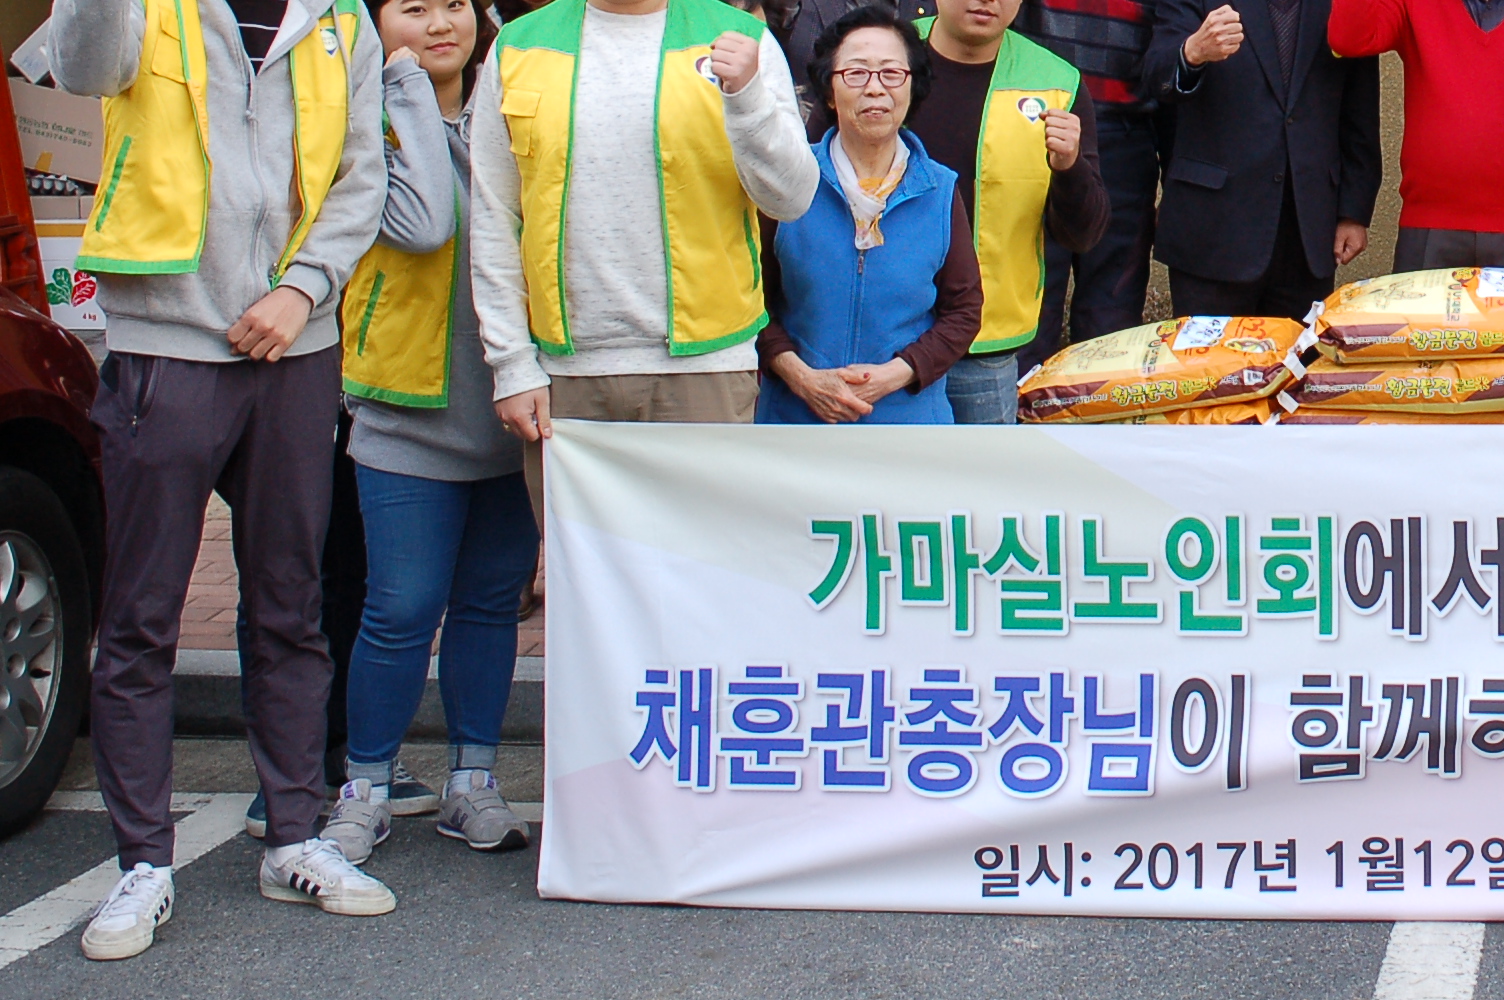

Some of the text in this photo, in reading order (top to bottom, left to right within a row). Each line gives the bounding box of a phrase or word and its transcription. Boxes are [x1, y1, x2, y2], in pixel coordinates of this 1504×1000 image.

[629, 664, 1248, 793] 채훈관총장님이
[973, 841, 1092, 898] 일시:
[1113, 840, 1298, 893] 2017년
